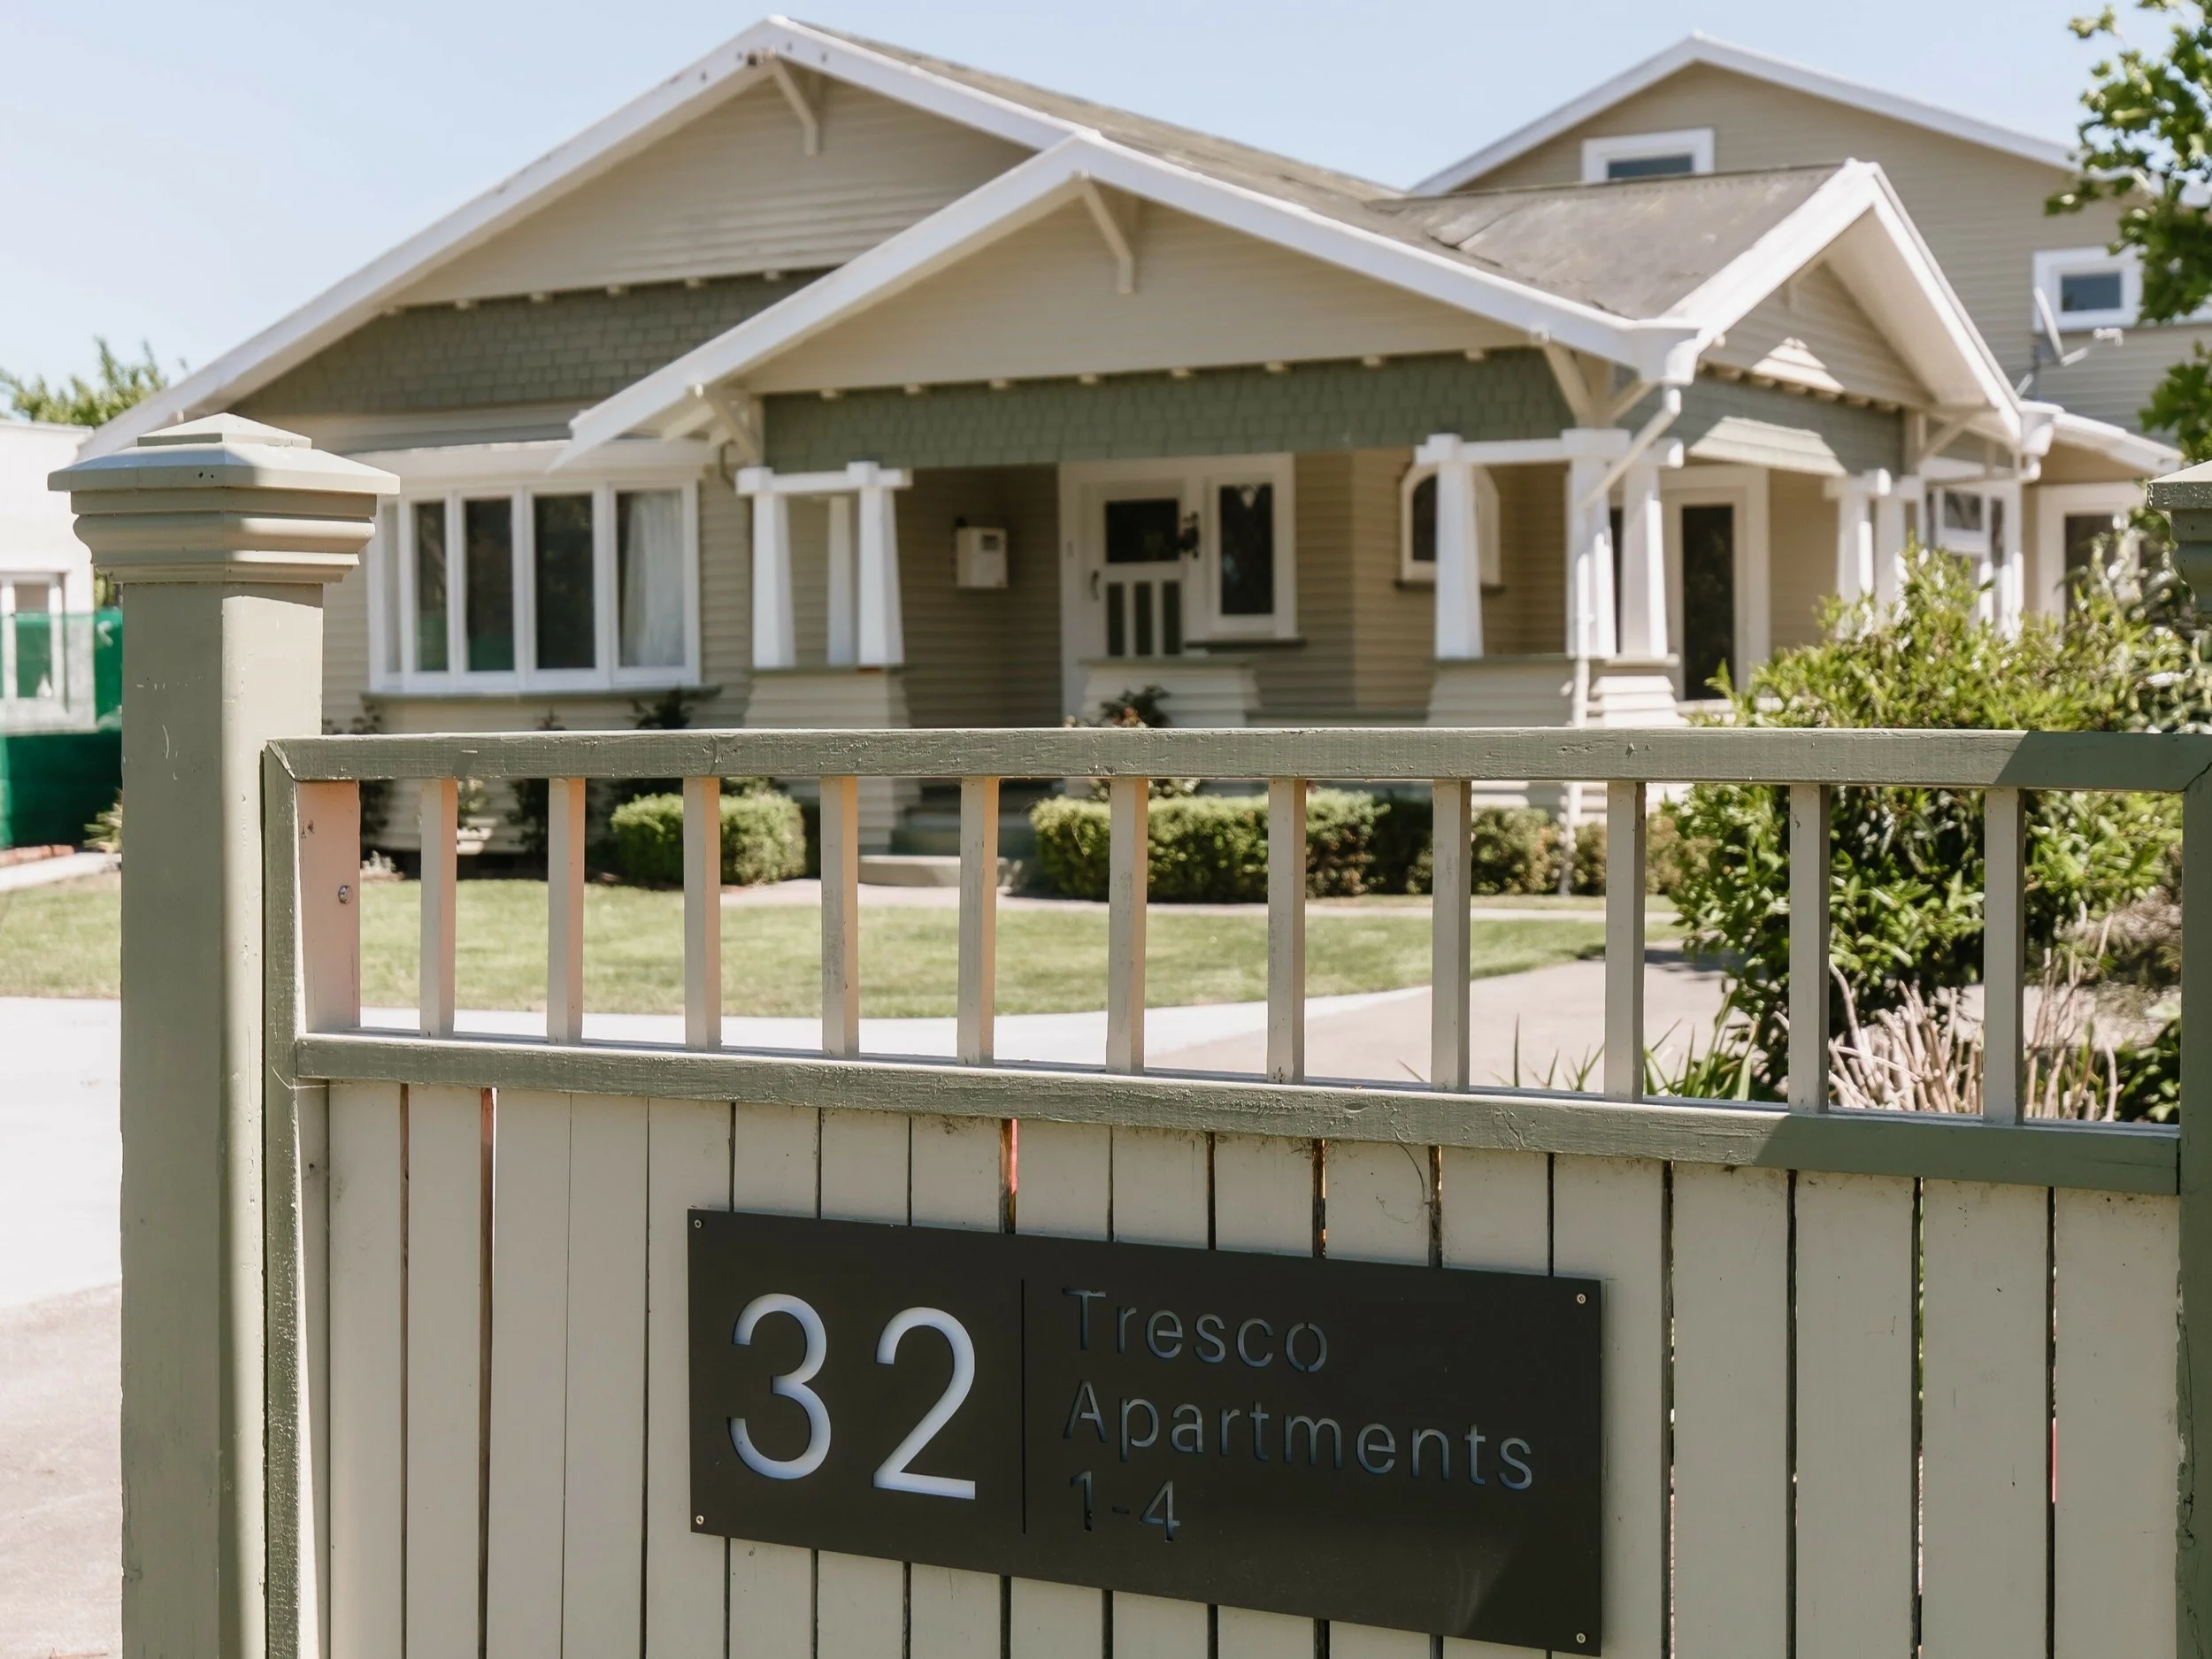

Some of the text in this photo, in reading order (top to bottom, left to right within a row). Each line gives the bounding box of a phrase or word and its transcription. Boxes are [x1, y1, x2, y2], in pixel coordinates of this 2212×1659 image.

[1064, 1287, 1327, 1372] Tresco
[728, 1293, 976, 1500] 32
[1064, 1380, 1533, 1490] Apartments
[1070, 1471, 1181, 1542] 1-4
